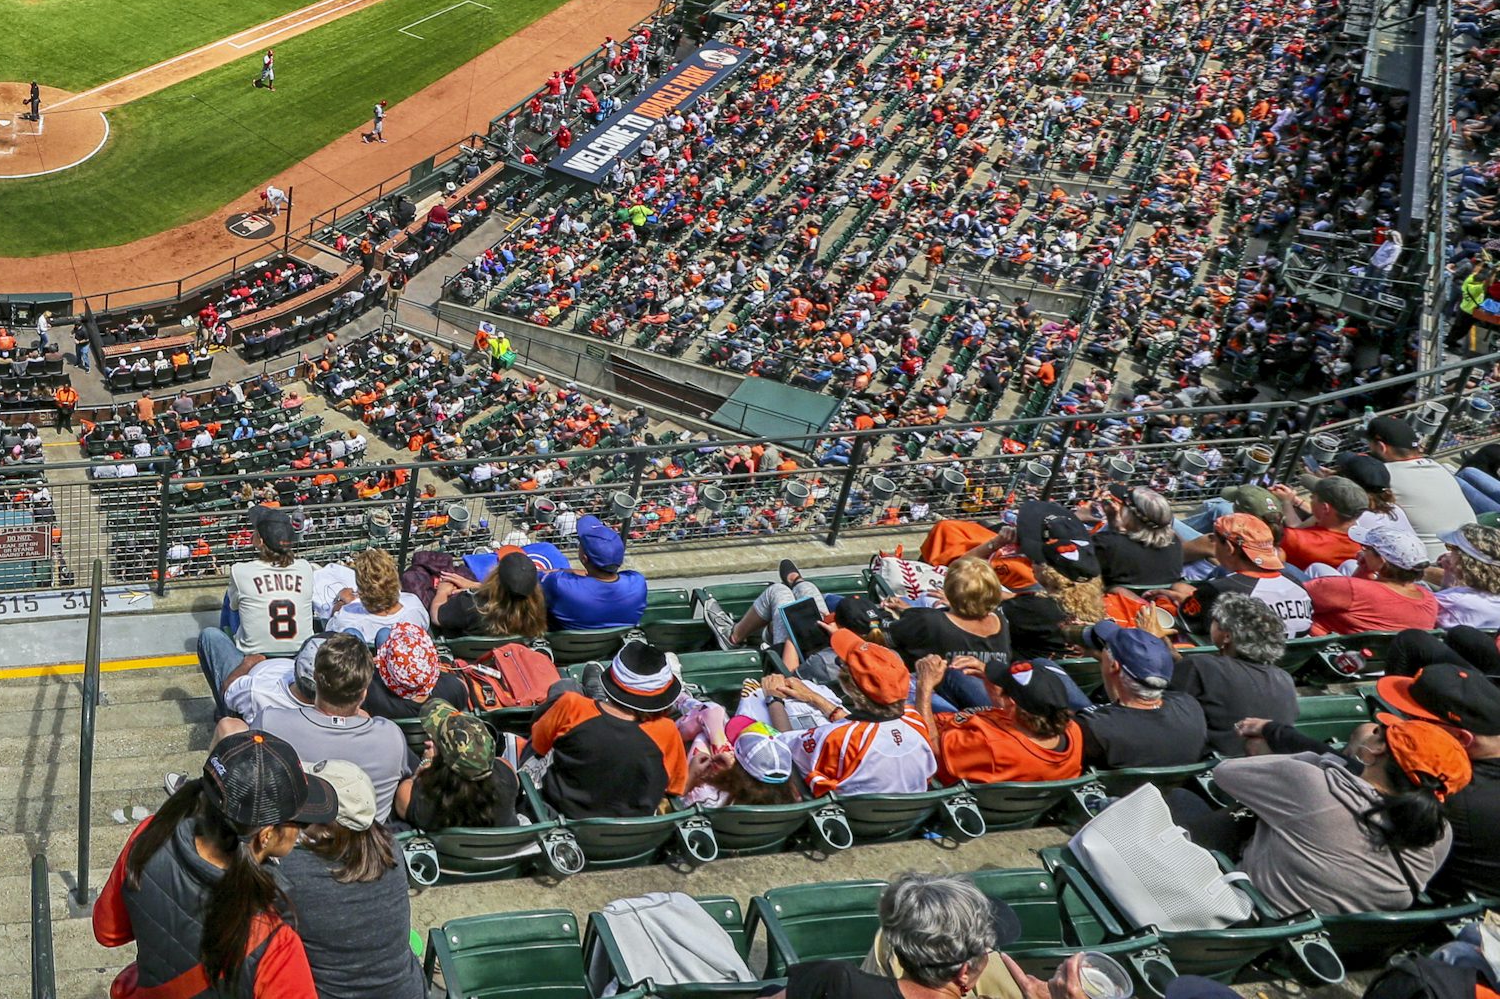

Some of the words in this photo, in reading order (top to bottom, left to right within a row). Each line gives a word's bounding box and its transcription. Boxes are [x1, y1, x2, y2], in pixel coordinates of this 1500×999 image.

[562, 125, 642, 174] WELCOME
[633, 81, 688, 120] ORACLE
[0, 525, 39, 536] PLEASE
[6, 535, 17, 543] DO
[17, 534, 33, 543] NOT
[252, 572, 303, 595] PENCE
[268, 598, 298, 640] 8
